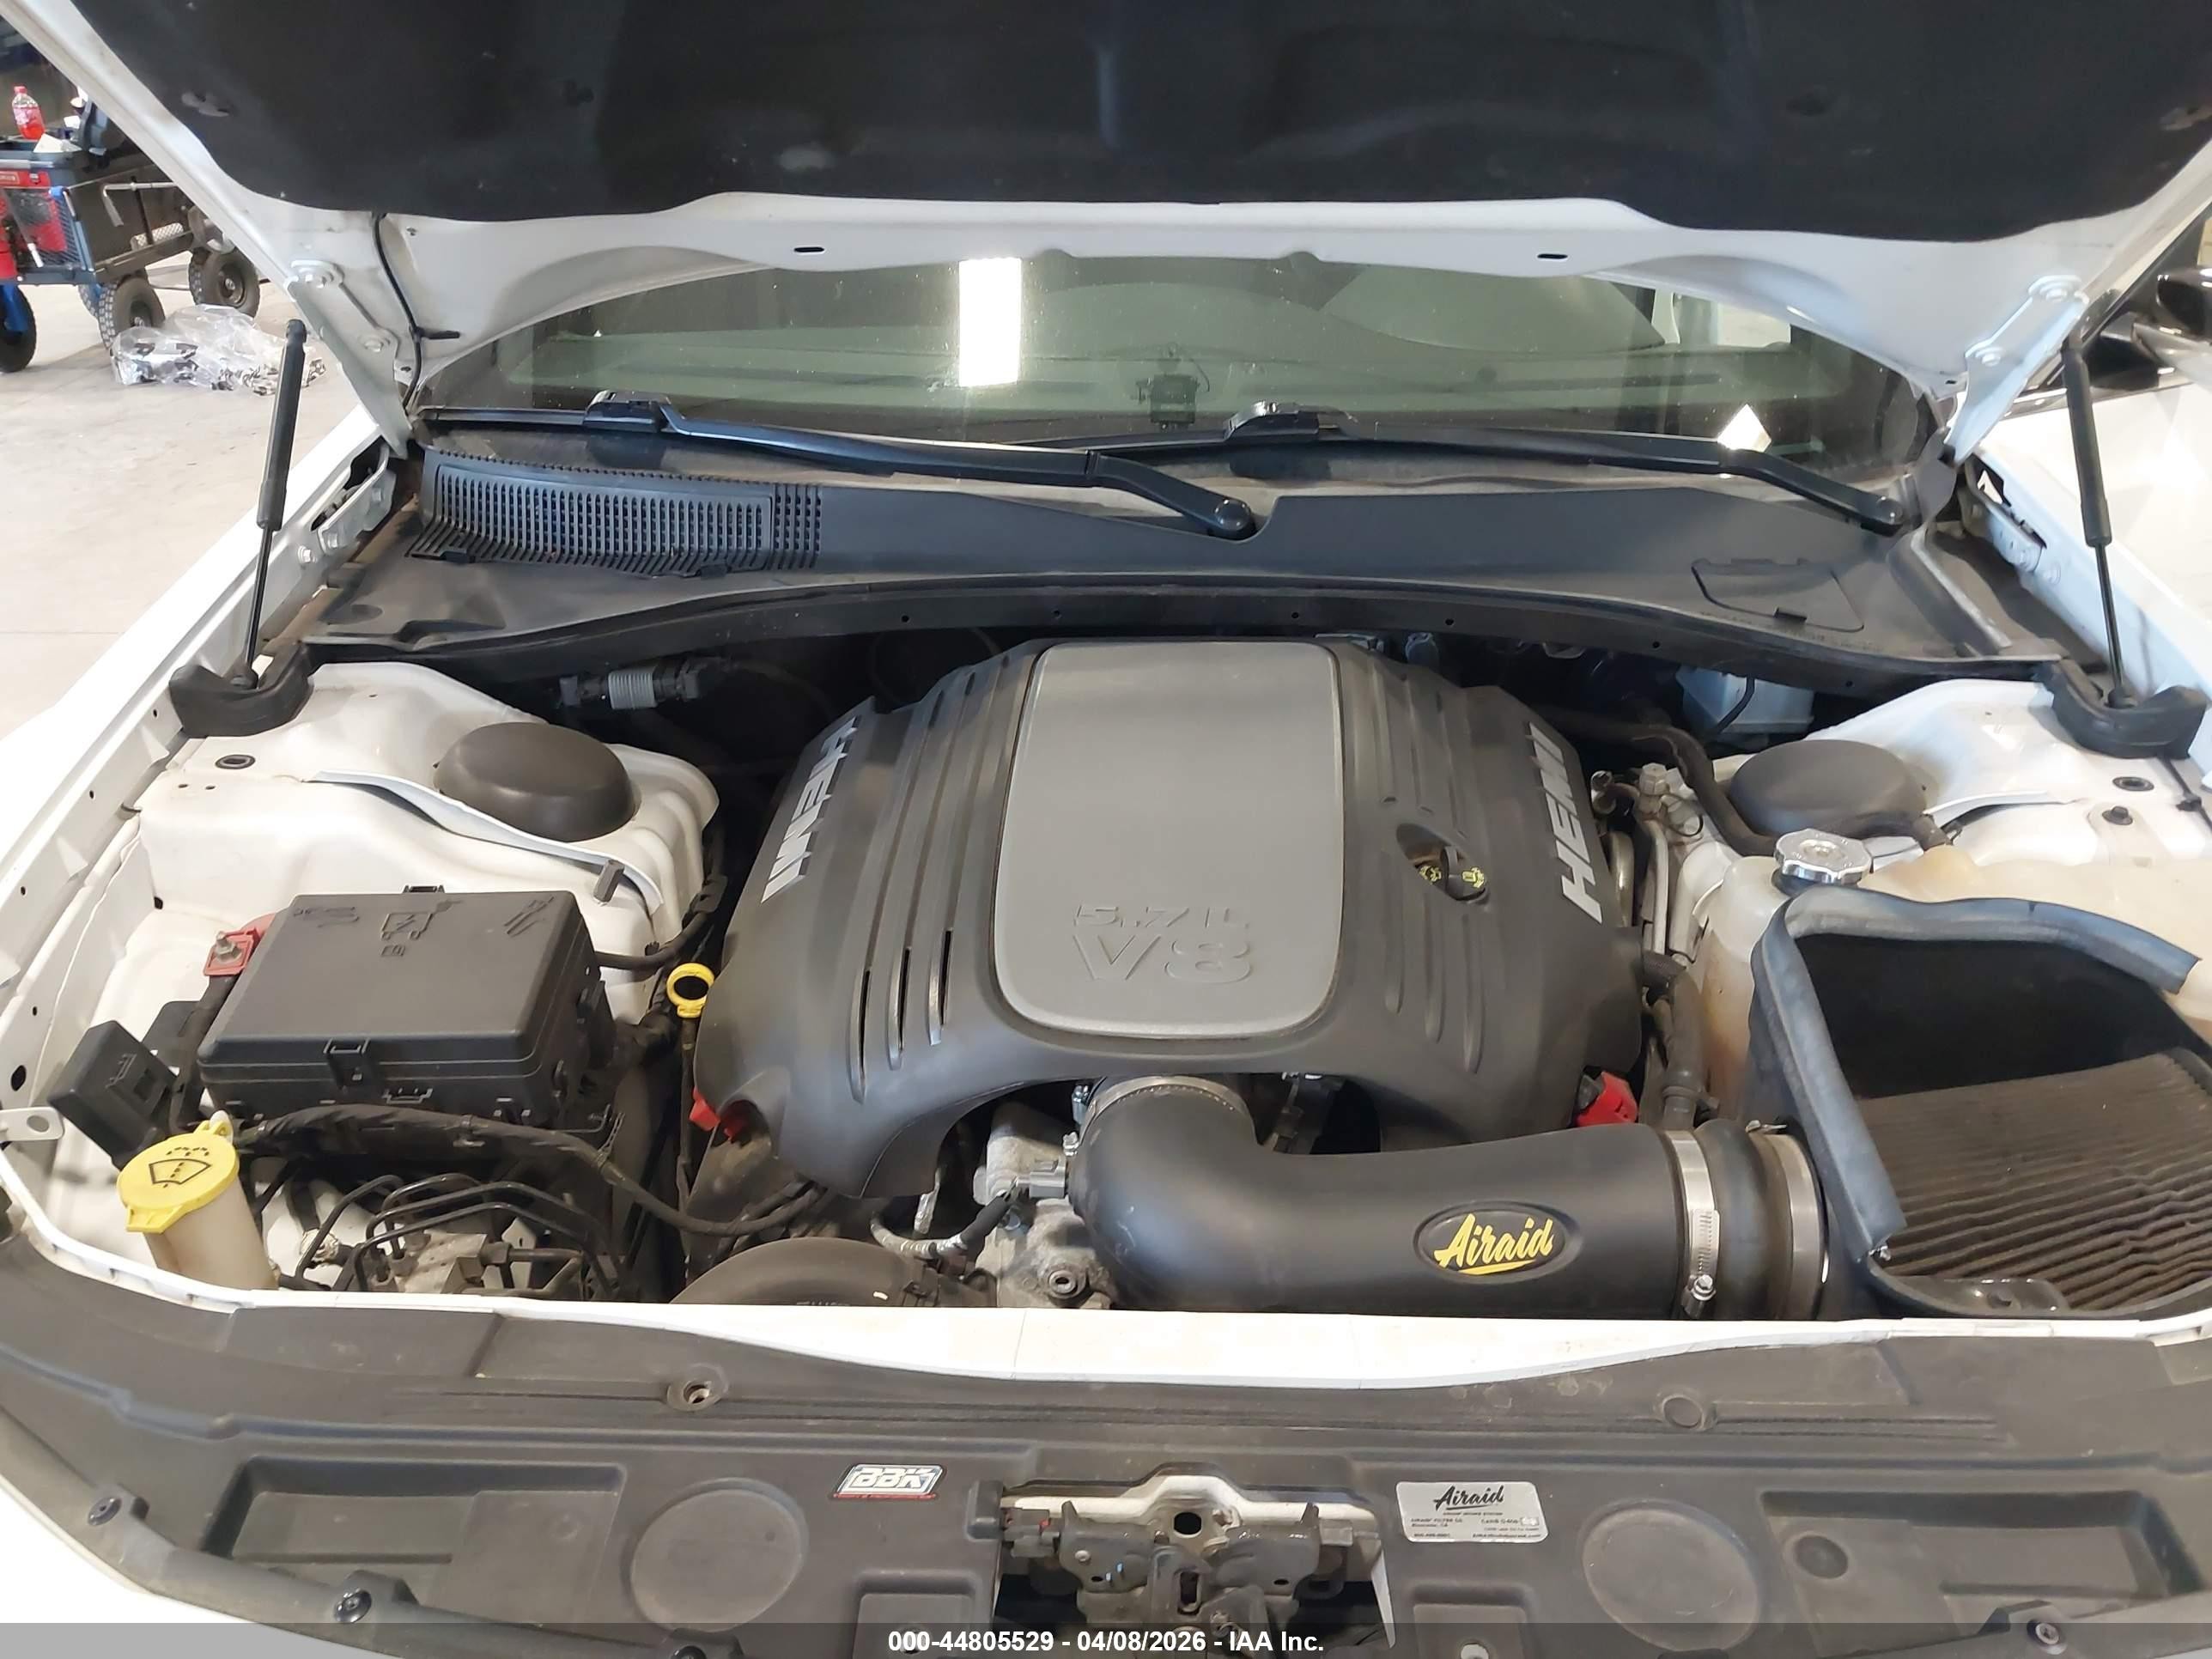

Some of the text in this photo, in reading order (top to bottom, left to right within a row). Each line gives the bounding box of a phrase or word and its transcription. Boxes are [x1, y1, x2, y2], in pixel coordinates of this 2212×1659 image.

[761, 716, 858, 903] HEMI
[1528, 721, 1603, 925] HEMI
[1073, 933, 1255, 986] V8
[1433, 1212, 1555, 1268] Airaid
[848, 1467, 934, 1490] BBK
[1433, 1485, 1504, 1511] Airaid
